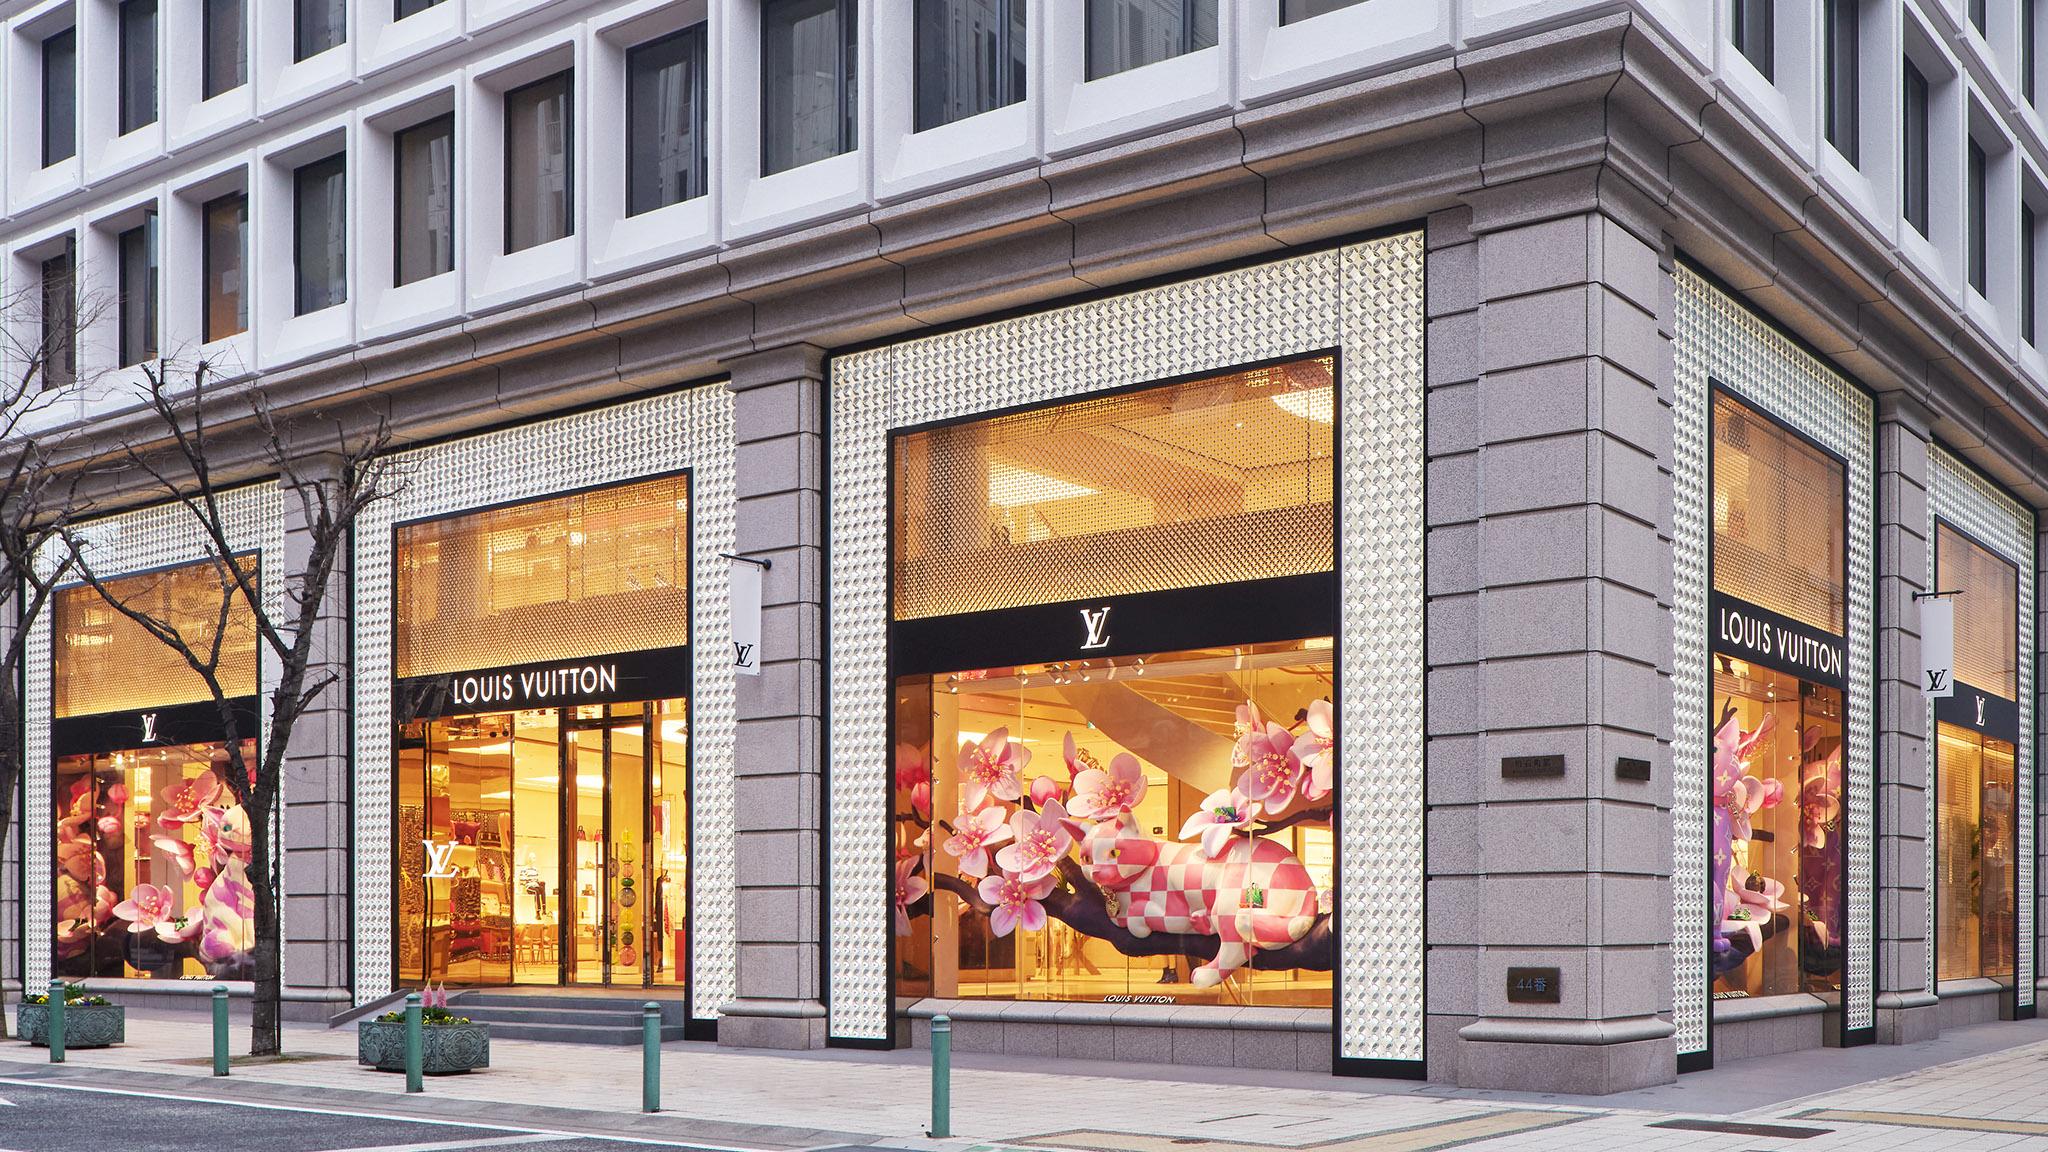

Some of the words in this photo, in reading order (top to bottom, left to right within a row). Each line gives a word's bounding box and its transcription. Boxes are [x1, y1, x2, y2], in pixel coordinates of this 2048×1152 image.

[1721, 608, 1771, 655] LOUIS
[1776, 628, 1843, 677] VUITTON
[454, 673, 513, 705] LOUIS
[520, 664, 617, 701] VUITTON
[1103, 994, 1132, 1003] LOUIS
[1133, 995, 1176, 1004] VUITTON
